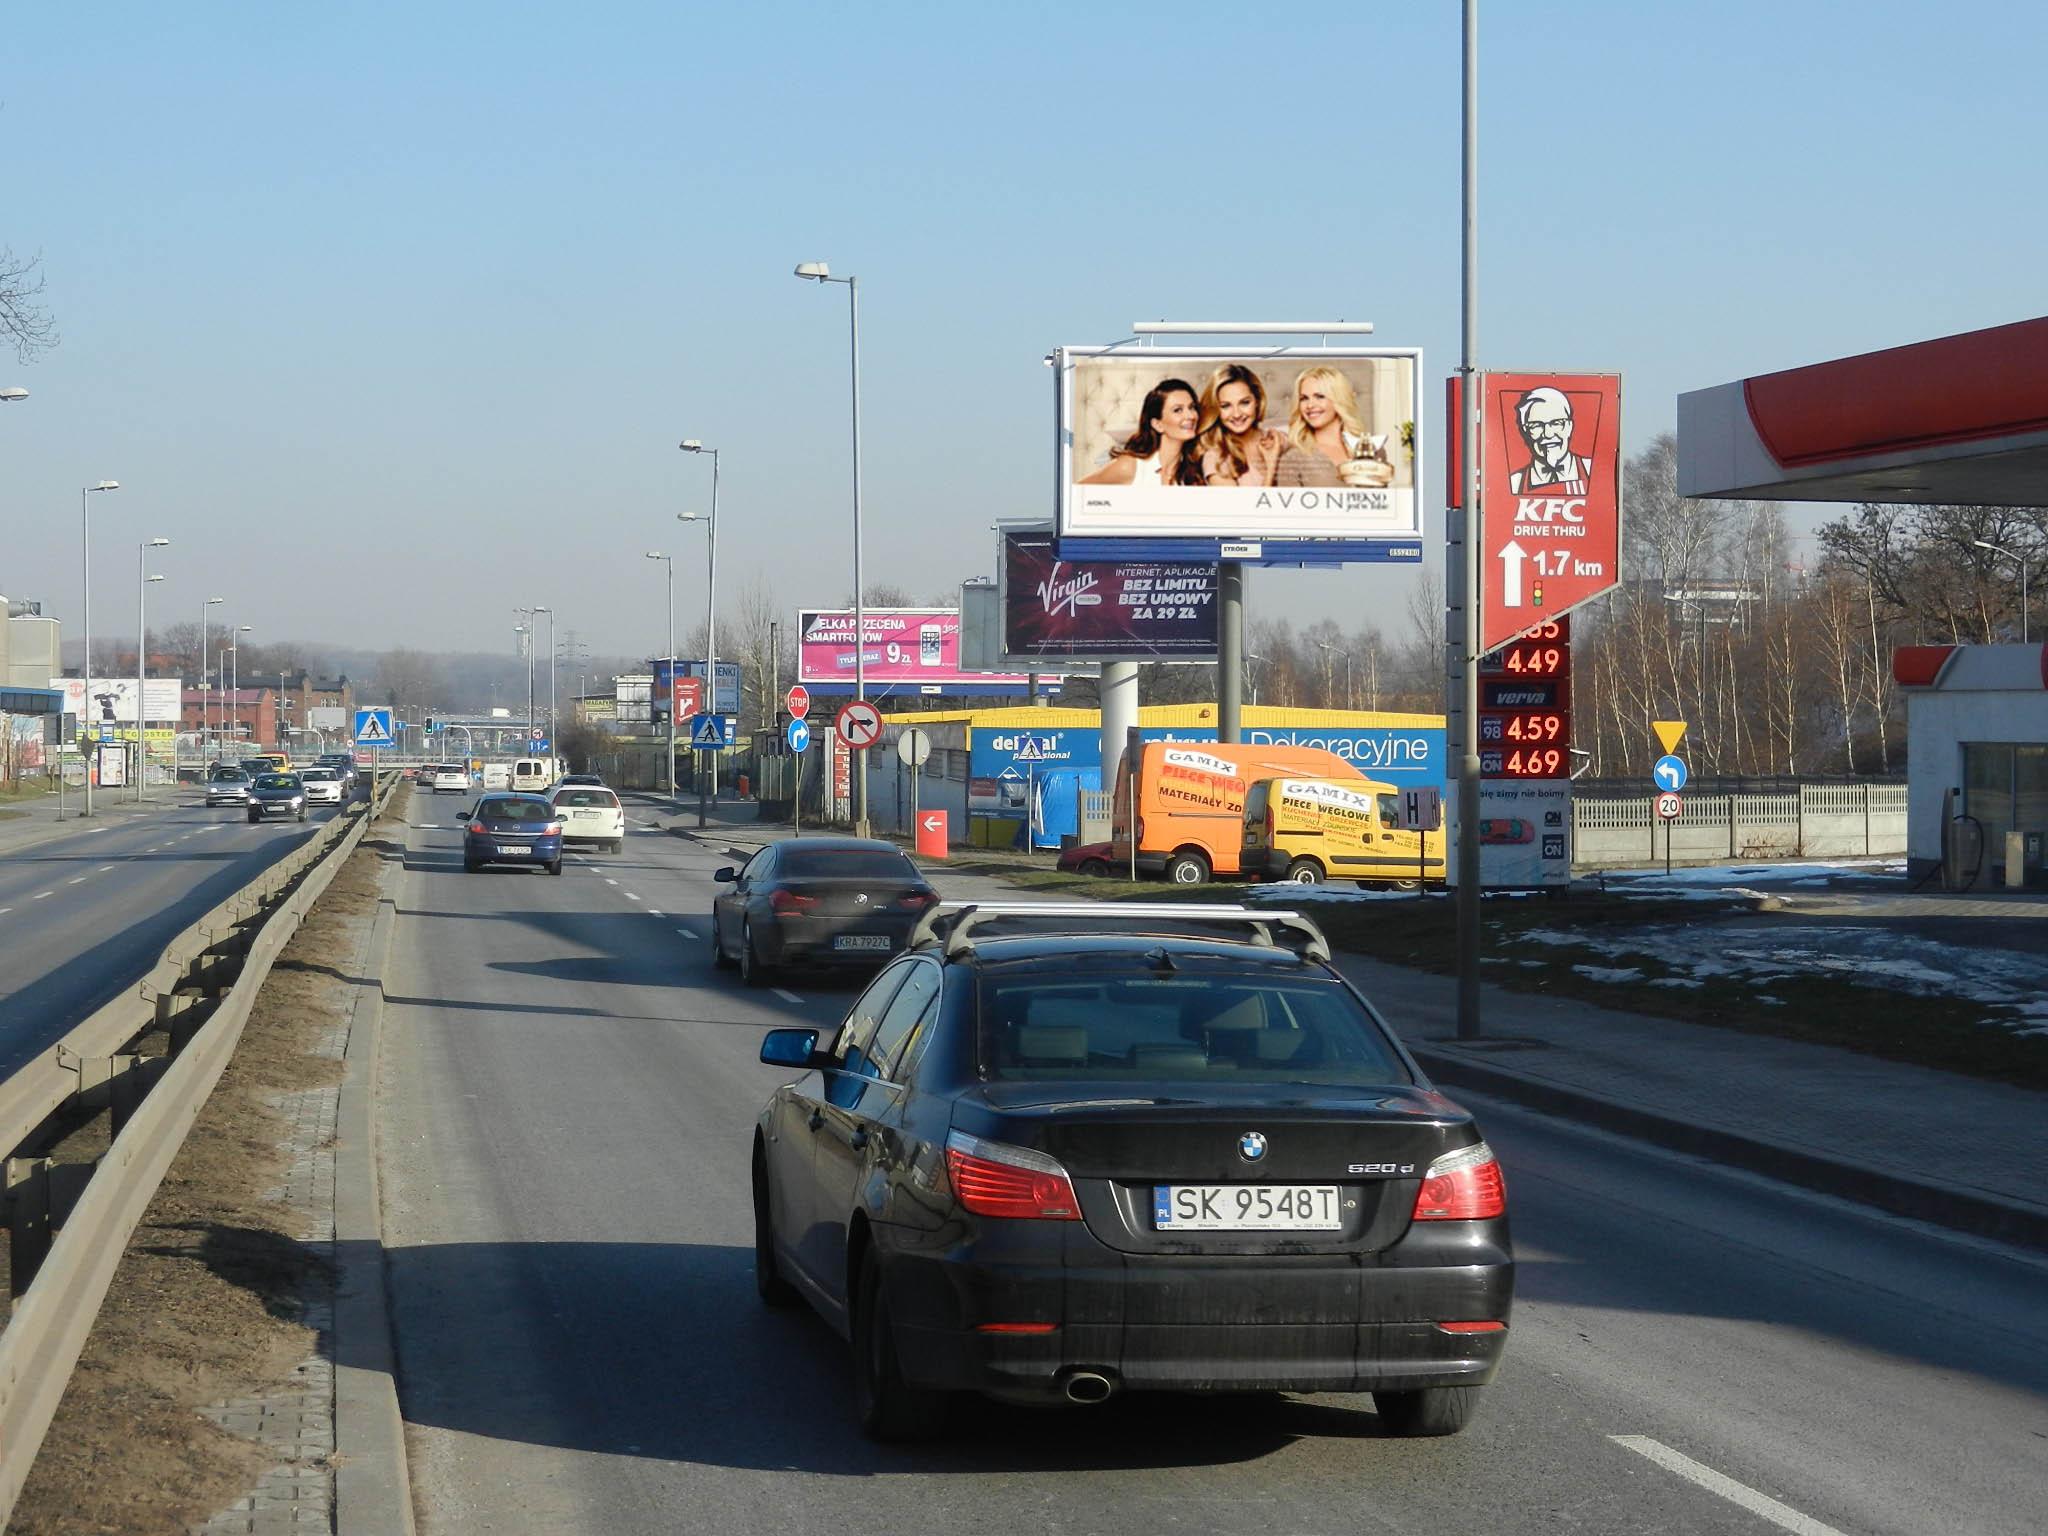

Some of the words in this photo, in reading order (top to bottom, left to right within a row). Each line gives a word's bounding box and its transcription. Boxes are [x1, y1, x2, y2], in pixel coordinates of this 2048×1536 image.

[1256, 491, 1343, 509] AVON
[1514, 498, 1586, 522] KFC
[1513, 526, 1549, 536] DRIVE
[1552, 526, 1586, 537] THRU
[1533, 550, 1570, 576] 1.7
[1574, 559, 1602, 576] km
[1115, 567, 1161, 578] INTERNET,
[1163, 567, 1217, 576] APLIKACJE
[1036, 561, 1099, 617] Virgin
[1123, 579, 1152, 591] BEZ
[1155, 578, 1207, 590] LIMITU
[1118, 593, 1147, 606] BEZ
[1150, 593, 1212, 605] UMOWY
[1132, 607, 1153, 619] ZA
[1156, 607, 1175, 619] 29
[1178, 607, 1197, 619] ZŁ
[821, 619, 847, 630] ELKA
[849, 618, 906, 630] PZECENA
[805, 631, 883, 643] SMARTFOÓW
[863, 653, 880, 662] ERAZ
[886, 643, 901, 664] 9
[1507, 649, 1560, 673] 4.49
[790, 698, 807, 708] STOP
[1496, 692, 1546, 705] verva
[1483, 726, 1501, 739] 98
[1507, 716, 1560, 740] 4.59
[1168, 753, 1233, 773] GAMIX
[1482, 760, 1502, 772] ON
[1507, 750, 1560, 774] 4.69
[1162, 764, 1207, 785] PIECE
[1159, 786, 1223, 809] MATERIAŁY
[1286, 783, 1367, 808] GAMIX
[1496, 789, 1519, 799] zimy
[1521, 789, 1536, 798] nie
[1537, 788, 1565, 799] boimy
[1282, 797, 1312, 810] PIECE
[1662, 800, 1678, 813] 20
[1544, 845, 1562, 856] ON
[840, 937, 857, 947] KRA
[1347, 1163, 1396, 1173] 520
[1400, 1163, 1415, 1174] d
[1176, 1188, 1222, 1220] SK
[1236, 1188, 1334, 1220] 9548T
[1158, 1208, 1170, 1218] PL
